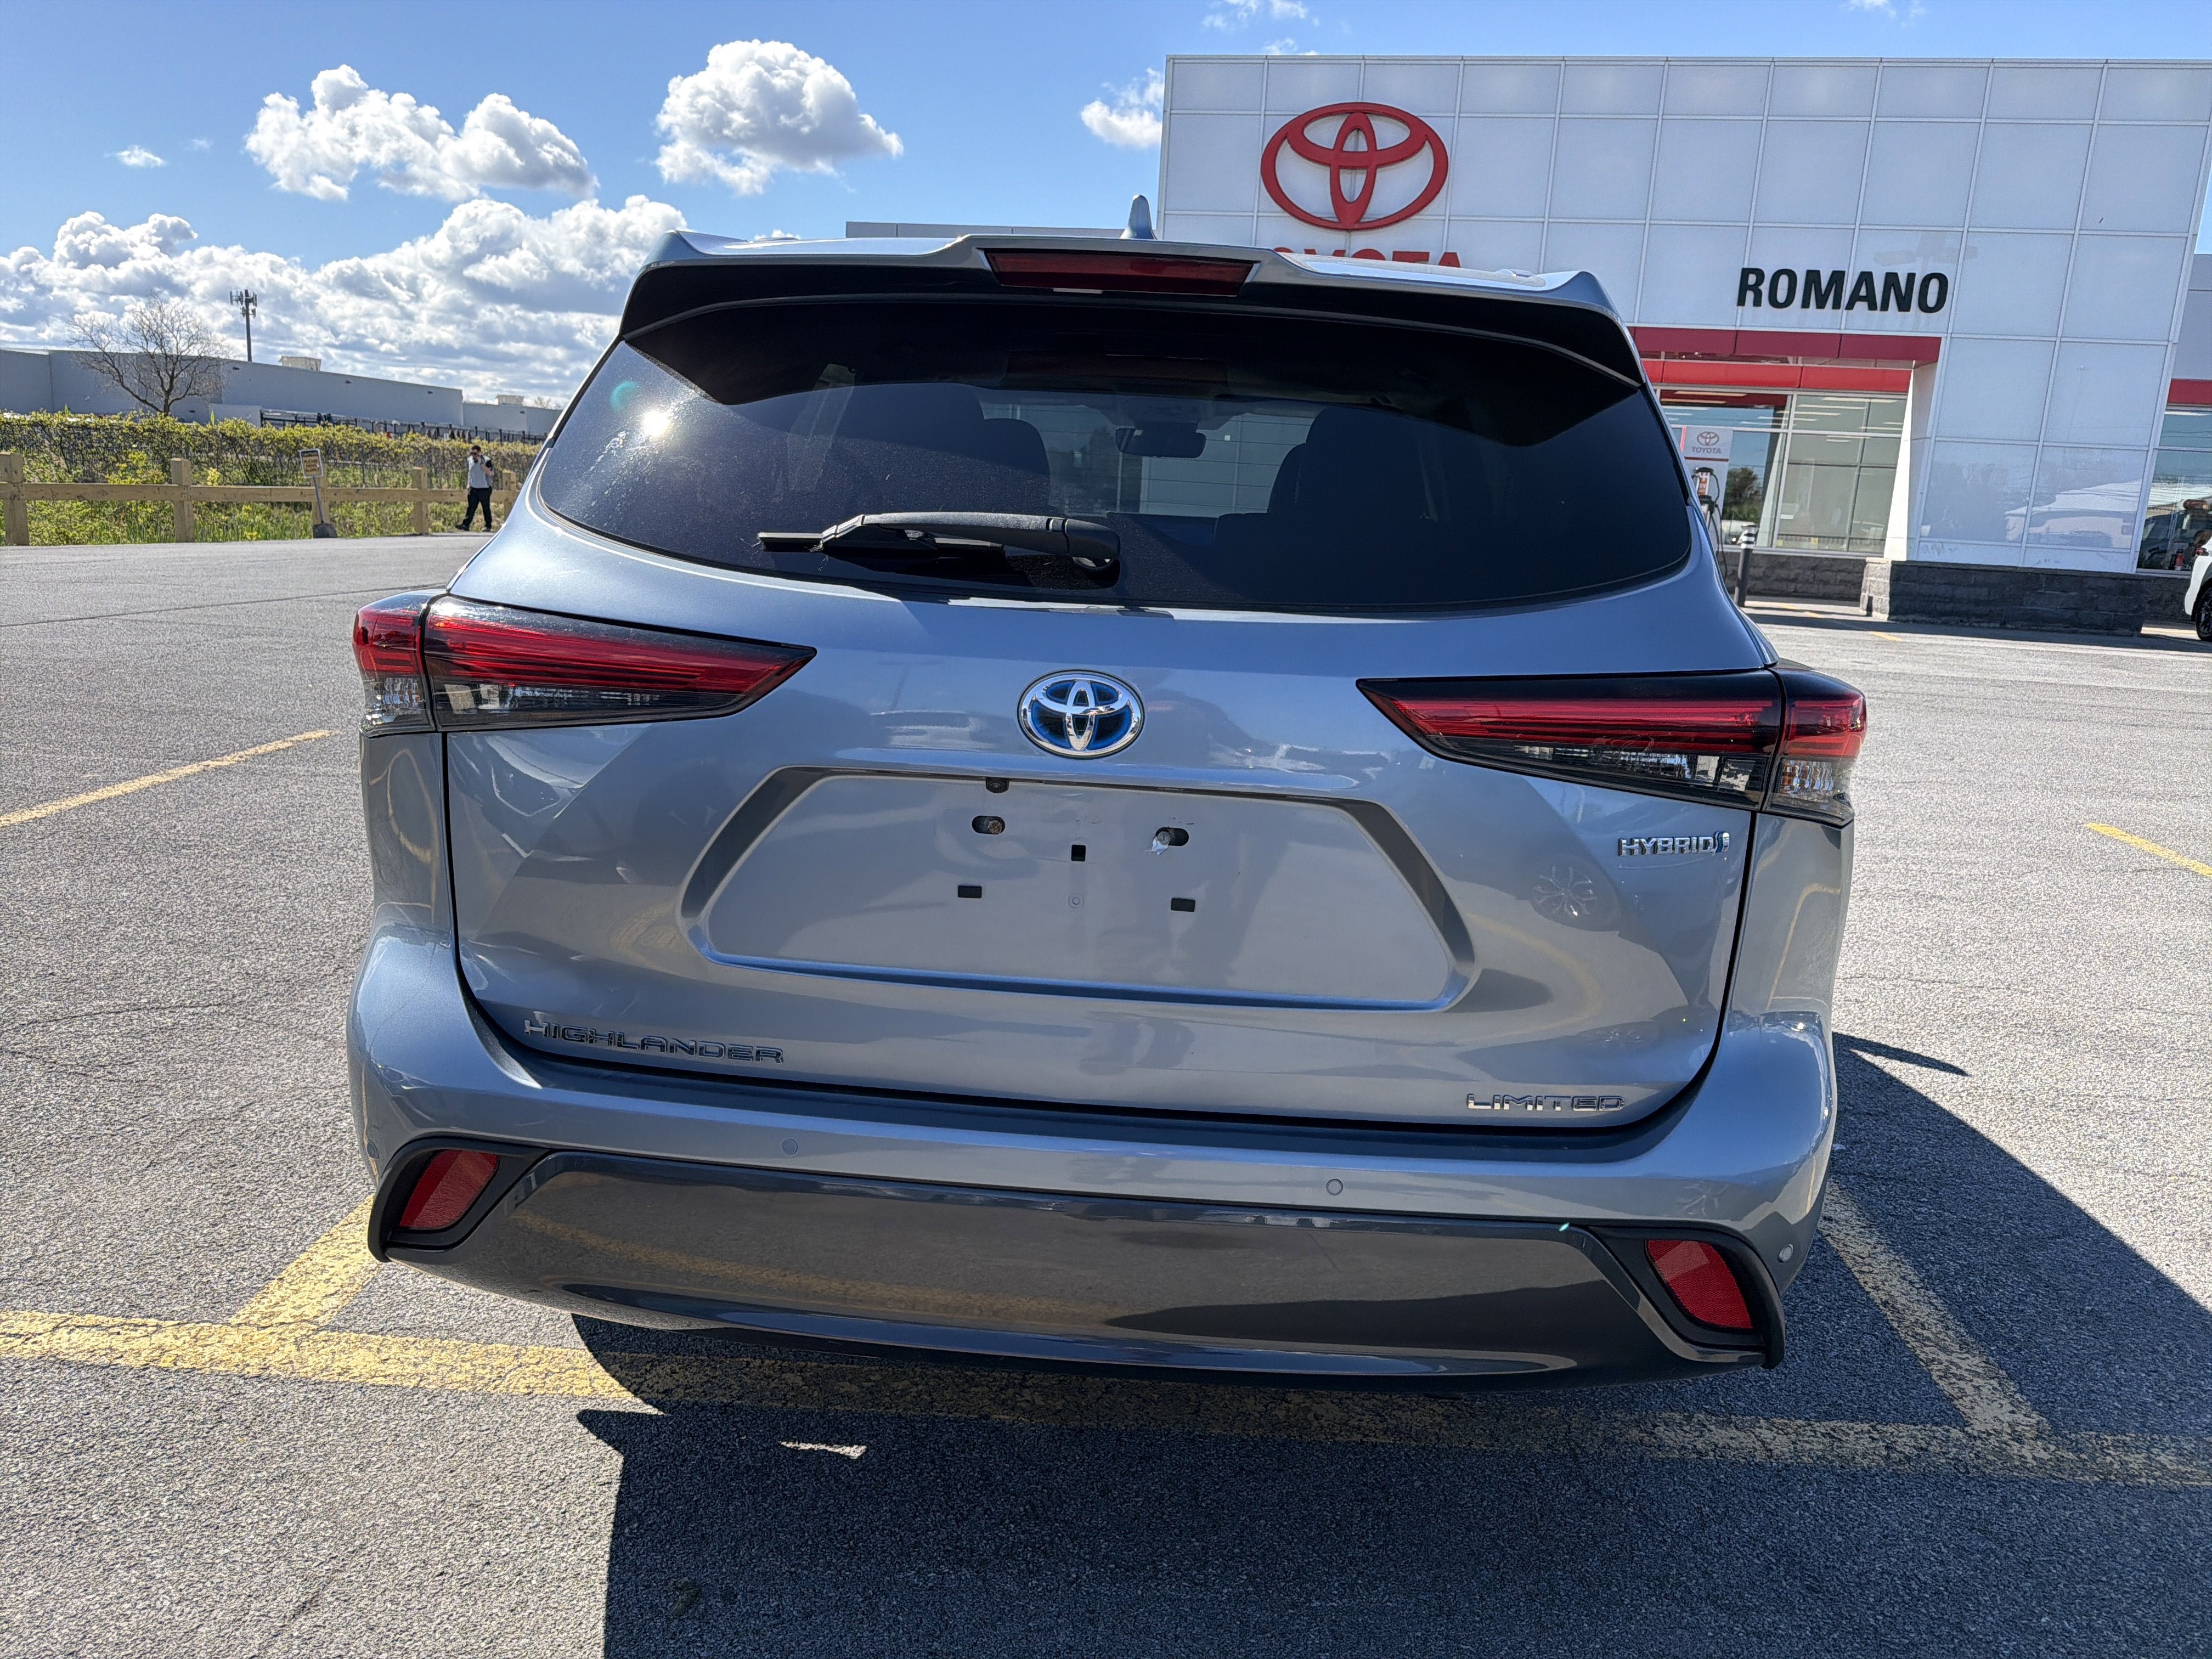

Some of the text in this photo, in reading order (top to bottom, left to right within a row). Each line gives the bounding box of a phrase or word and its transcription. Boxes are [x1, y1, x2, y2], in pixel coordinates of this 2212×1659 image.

[1736, 267, 1949, 313] ROMANO
[1618, 837, 1714, 856] HYBRID
[524, 1019, 785, 1064] HIGHLANDER
[1467, 1093, 1624, 1111] LIMITED
